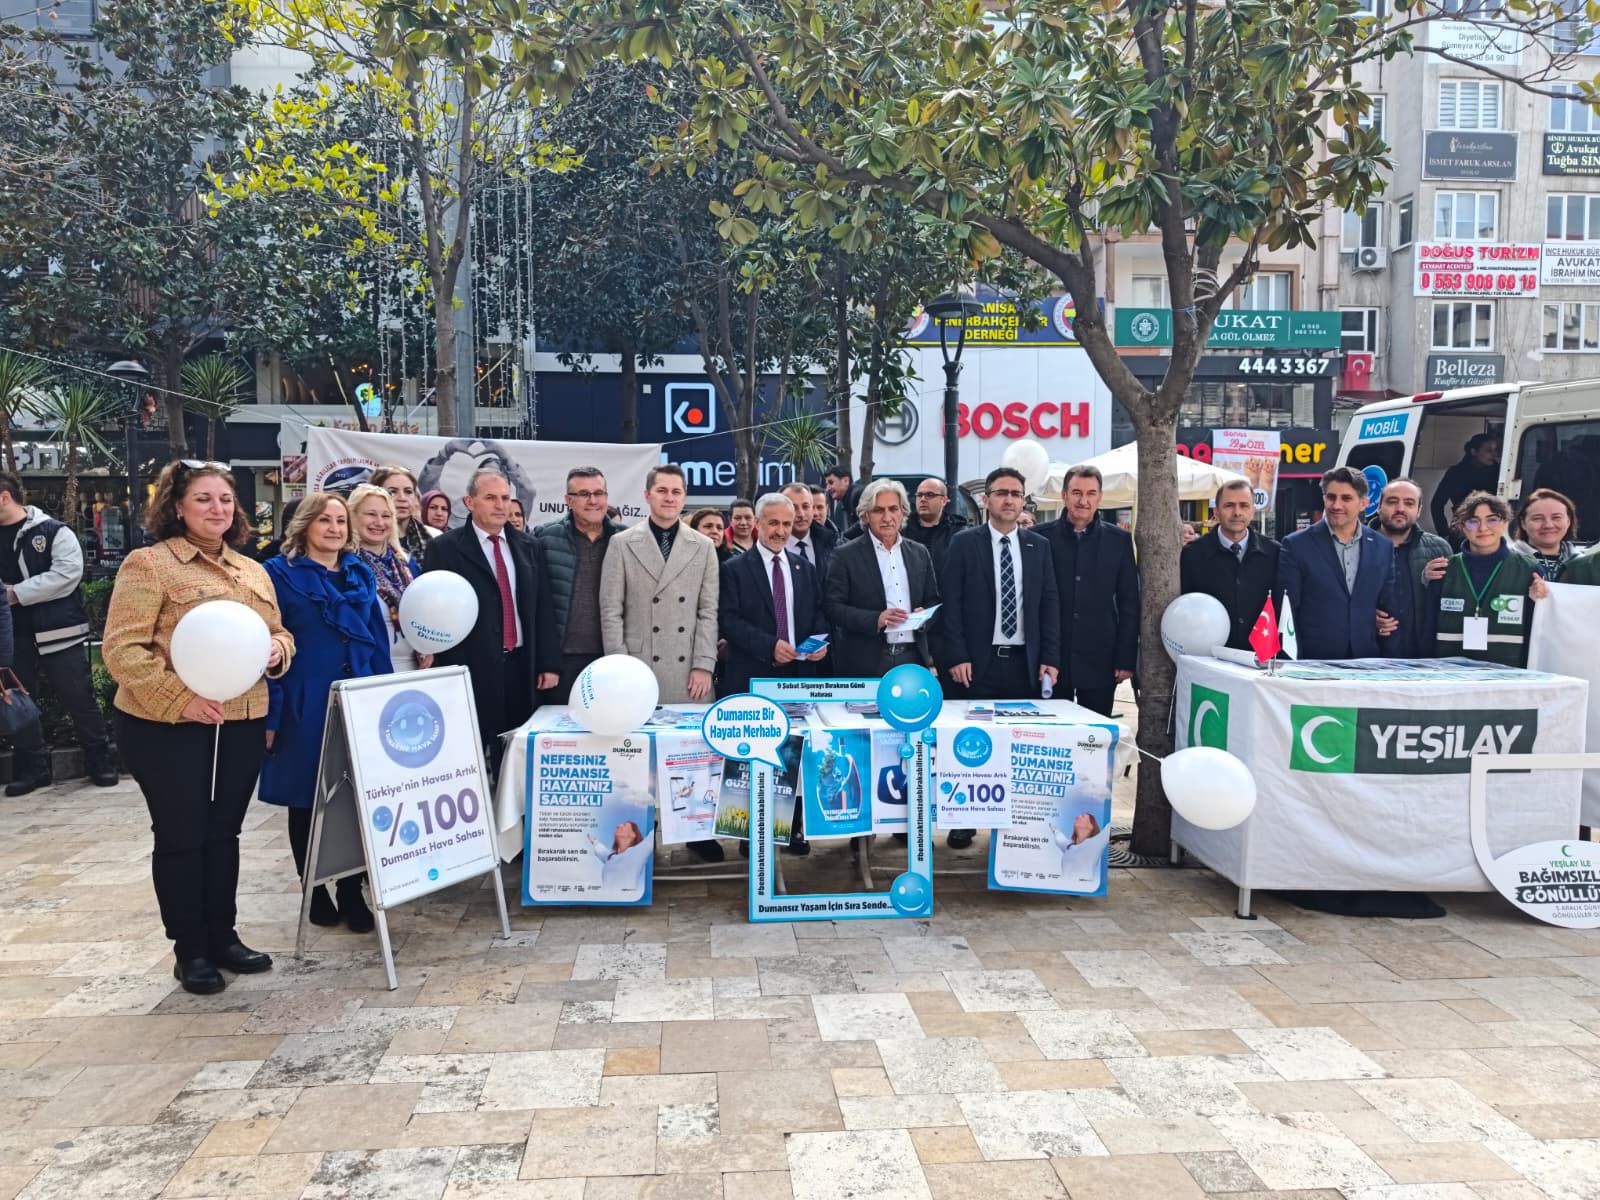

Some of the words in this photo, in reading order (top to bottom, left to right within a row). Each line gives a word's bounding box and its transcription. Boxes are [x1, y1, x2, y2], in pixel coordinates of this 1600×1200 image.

[1441, 41, 1472, 51] Sümeyra
[1567, 143, 1599, 154] Avukat
[1429, 157, 1454, 167] İSMET
[1454, 159, 1480, 168] FARUK
[1481, 160, 1512, 169] ARSLAN
[1547, 154, 1579, 168] Tuğba
[1420, 243, 1474, 260] DOĞUŞ
[1478, 244, 1540, 260] TURİZM
[1562, 247, 1585, 256] HUKUK
[1551, 266, 1586, 277] İBRAHİM
[1421, 272, 1430, 289] 0
[1434, 272, 1462, 289] 553
[1465, 273, 1493, 290] 908
[1520, 274, 1536, 290] 18
[981, 301, 1017, 313] ANİSA
[1213, 314, 1282, 328] UKAT
[965, 328, 1018, 340] DERNEĞİ
[1220, 332, 1241, 341] GÜL
[1242, 331, 1276, 342] ÖLMEZ
[1238, 357, 1278, 374] 444
[1280, 358, 1330, 374] 3367
[1435, 359, 1497, 376] Belleza
[1434, 377, 1460, 387] Kuaför
[943, 402, 1090, 438] BOSCH
[1364, 417, 1400, 437] MOBİL
[1280, 441, 1326, 463] ner
[782, 682, 800, 690] Şubat
[801, 682, 825, 690] Sigarayı
[717, 708, 760, 721] Dumansız
[762, 706, 775, 720] Bir
[710, 725, 741, 740] Hayata
[742, 724, 782, 737] Merhaba
[612, 746, 642, 754] DUMANSIZ
[1011, 743, 1071, 758] NEFESİNİZ
[1370, 724, 1523, 764] YEŞİLAY
[540, 754, 607, 766] NEFESİNİZ
[1011, 756, 1073, 771] DUMANSIZ
[540, 767, 610, 779] DUMANSIZ
[940, 771, 971, 779] Türkiye'nin
[1011, 768, 1073, 784] HAYATINIZ
[366, 781, 420, 801] Türkiye'nin
[422, 772, 453, 787] Havası
[455, 764, 478, 779] Artık
[541, 780, 611, 793] HAYATINIZ
[381, 845, 428, 868] Dumansız
[429, 838, 453, 852] Hava
[455, 828, 485, 843] Sahası
[1549, 860, 1578, 870] YEŞİLAY
[1580, 858, 1591, 868] İLE
[758, 903, 799, 913] Dumansız
[800, 902, 827, 914] Yaşam
[828, 900, 844, 912] İçin
[844, 901, 861, 910] Sıra
